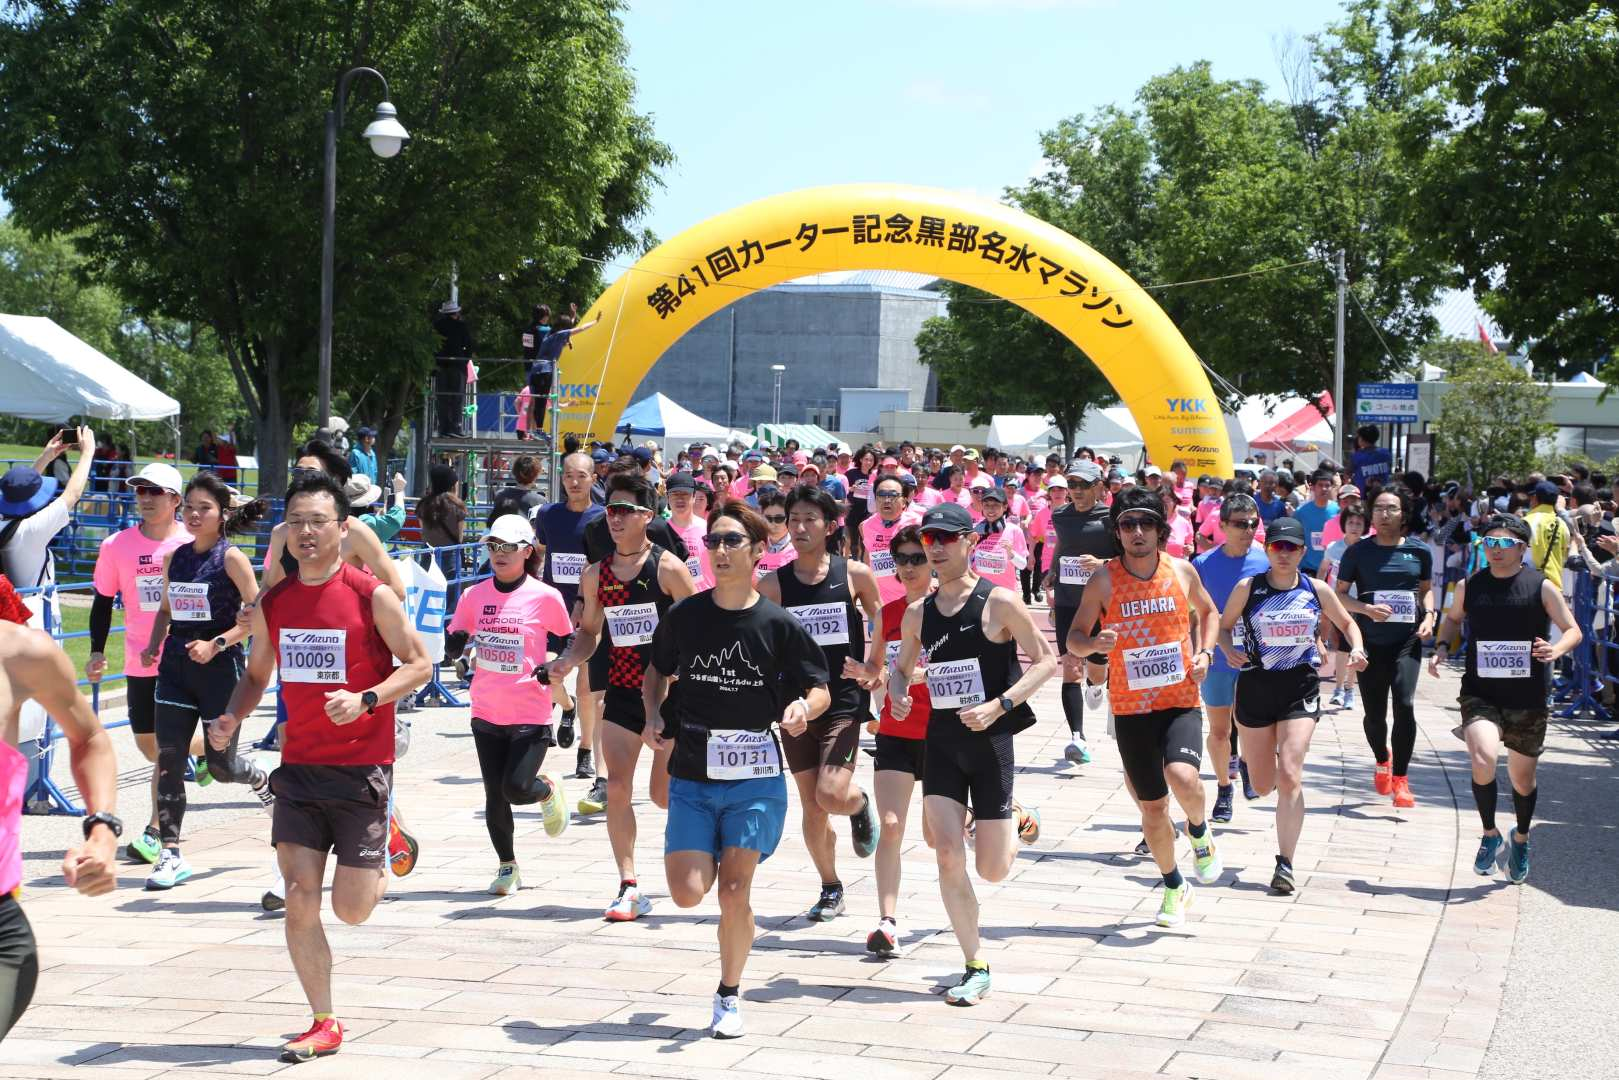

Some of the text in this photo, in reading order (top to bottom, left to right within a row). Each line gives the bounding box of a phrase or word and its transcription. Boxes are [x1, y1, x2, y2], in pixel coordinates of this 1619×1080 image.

[647, 214, 1133, 329] 第41回カーター記念黒部名水マラソン
[560, 384, 601, 398] YKK
[1167, 399, 1206, 412] YKK
[1120, 596, 1176, 618] UEHARA
[614, 620, 653, 637] 10070
[1269, 625, 1308, 638] 10507
[286, 651, 336, 668] 10009
[479, 647, 516, 663] 10508
[1484, 656, 1524, 668] 10036
[317, 671, 340, 680] 東京都
[721, 667, 736, 677] 1st
[1134, 660, 1177, 679] 10086
[931, 679, 973, 697] 10127
[718, 749, 768, 766] 10131
[752, 766, 774, 775] 滑川市
